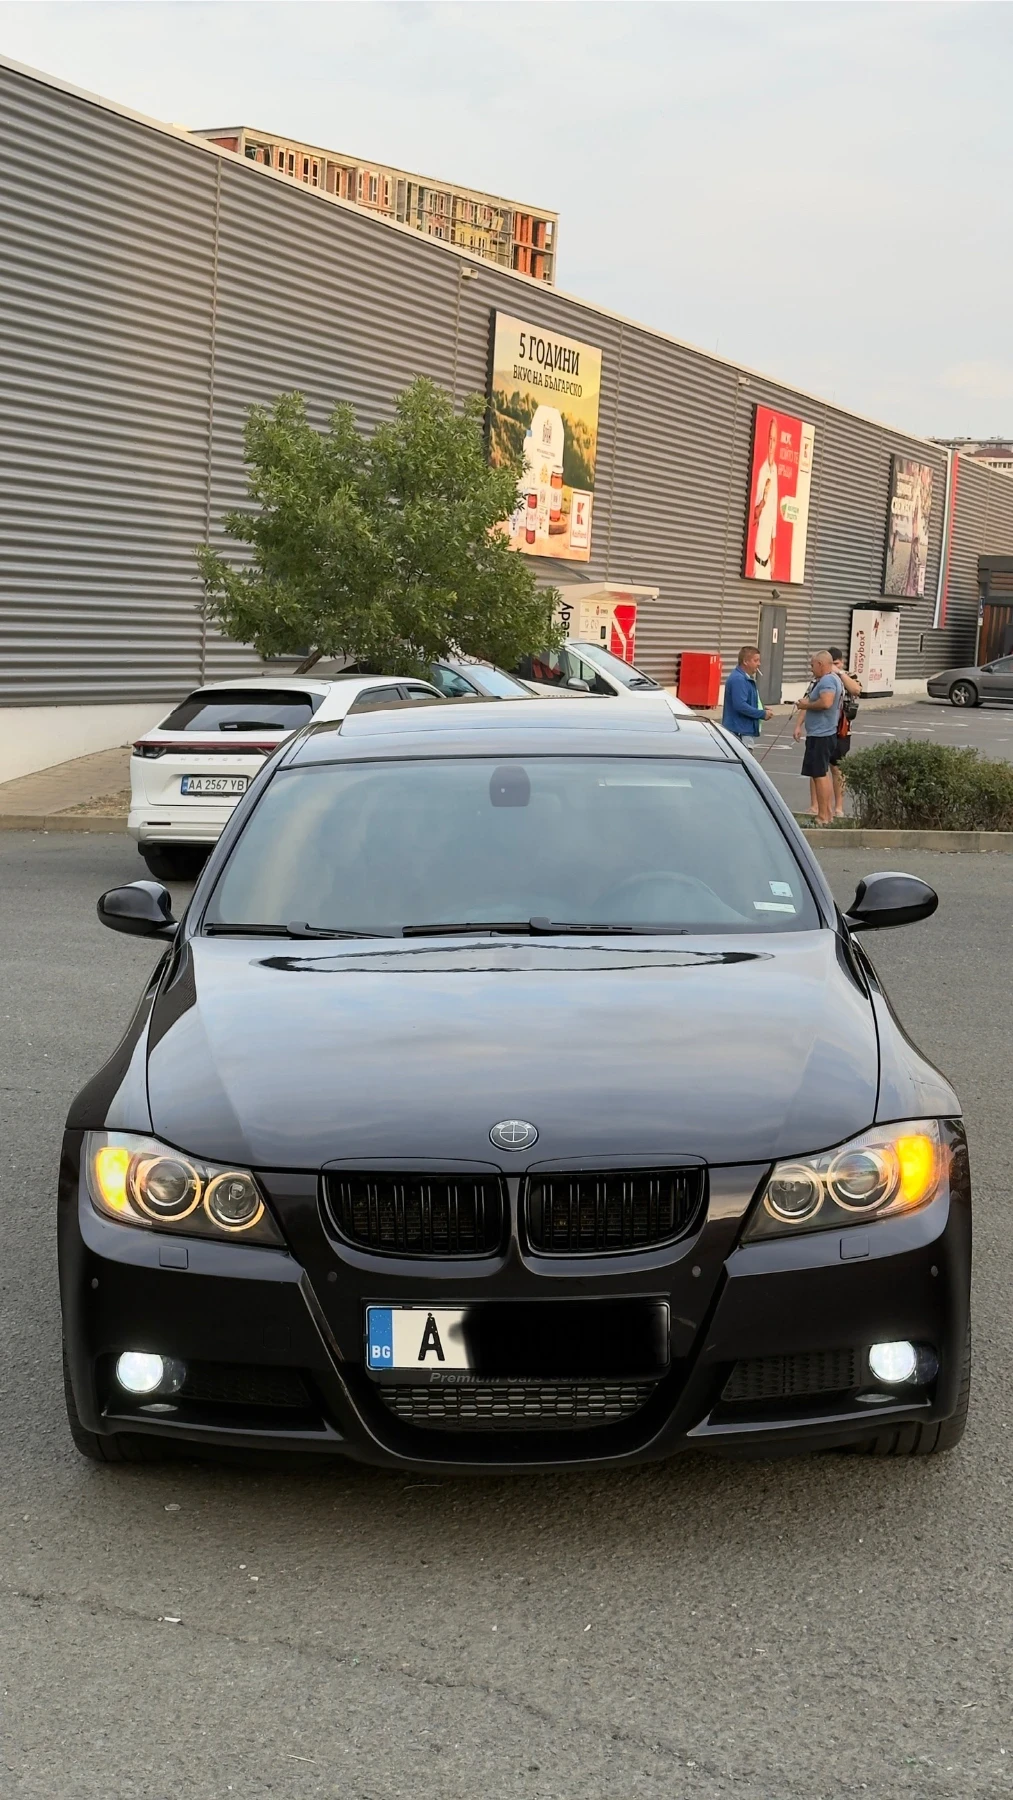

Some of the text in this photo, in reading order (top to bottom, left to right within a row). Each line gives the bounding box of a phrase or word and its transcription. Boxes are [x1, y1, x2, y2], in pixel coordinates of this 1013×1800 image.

[519, 332, 580, 377] 5 ГОДИНИ
[513, 364, 583, 398] ВКУС НА БЪЛГАРСКО
[857, 636, 866, 674] easybox
[188, 779, 245, 791] AA 2567 YB
[371, 1345, 391, 1359] BG
[418, 1312, 446, 1361] A
[430, 1372, 500, 1384] Premium
